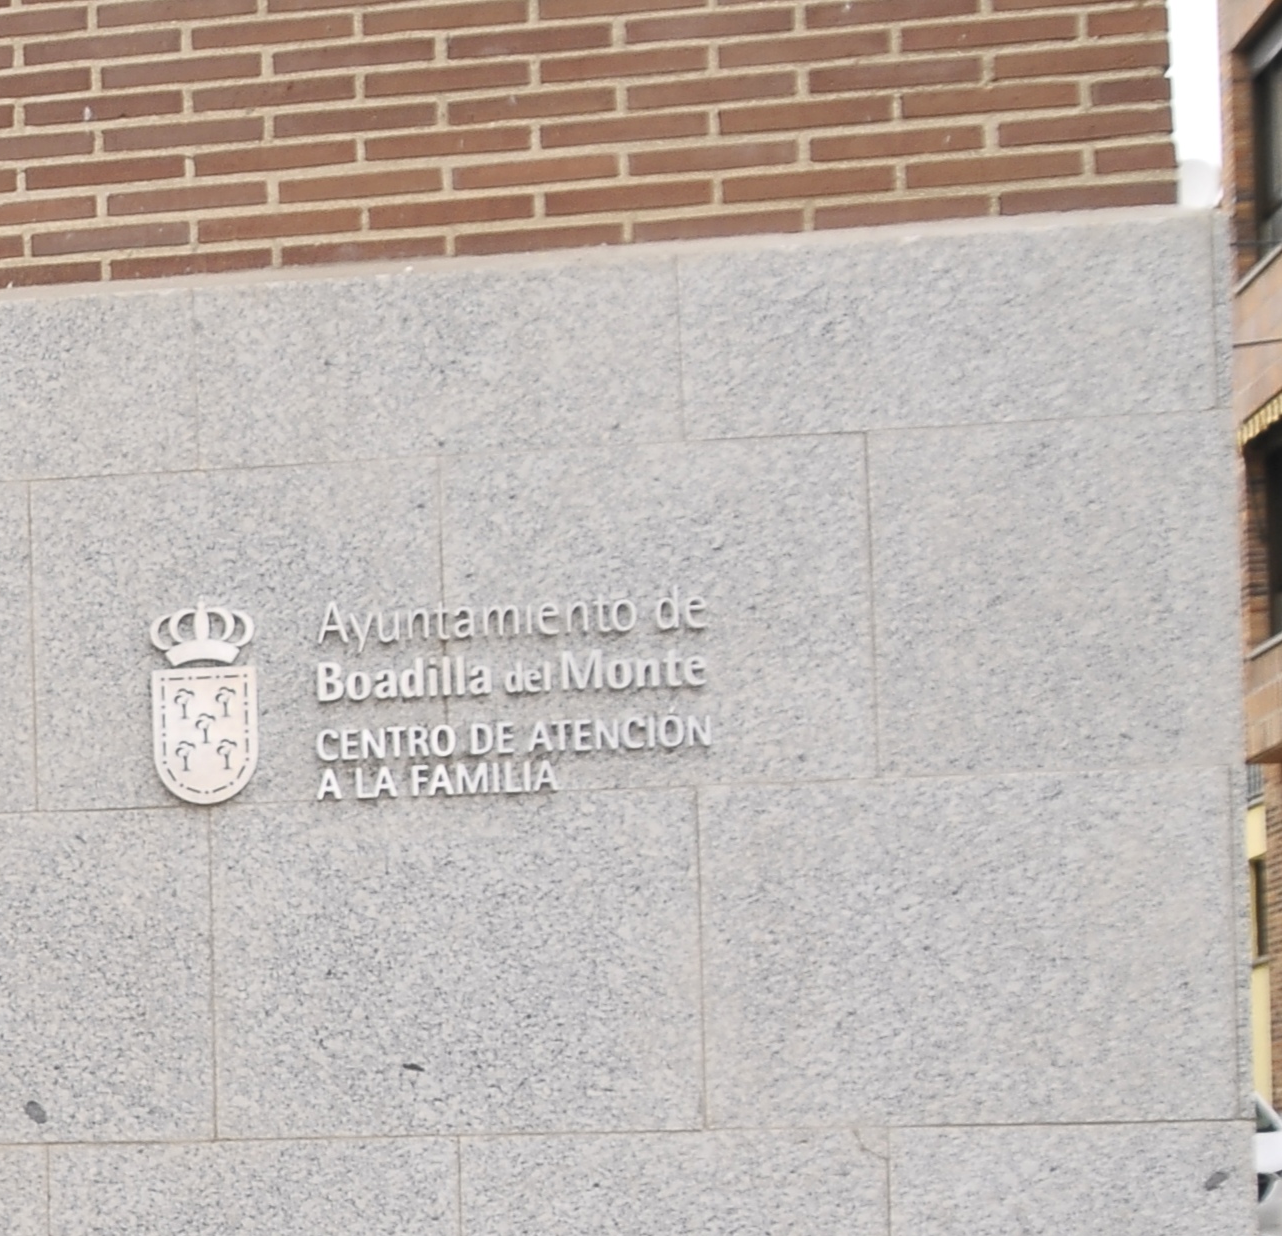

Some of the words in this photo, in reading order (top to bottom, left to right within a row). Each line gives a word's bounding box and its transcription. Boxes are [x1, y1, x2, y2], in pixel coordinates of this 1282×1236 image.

[317, 595, 636, 652] Ayuntamiento
[655, 586, 709, 633] de
[316, 655, 492, 703] Boadilla
[504, 662, 551, 693] del
[561, 649, 708, 692] Monte
[316, 724, 457, 763] CENTRO
[470, 721, 514, 757] DE
[525, 704, 712, 752] ATENCIÓN
[317, 768, 342, 801] A
[355, 765, 398, 800] LA
[411, 759, 559, 797] FAMILIA
